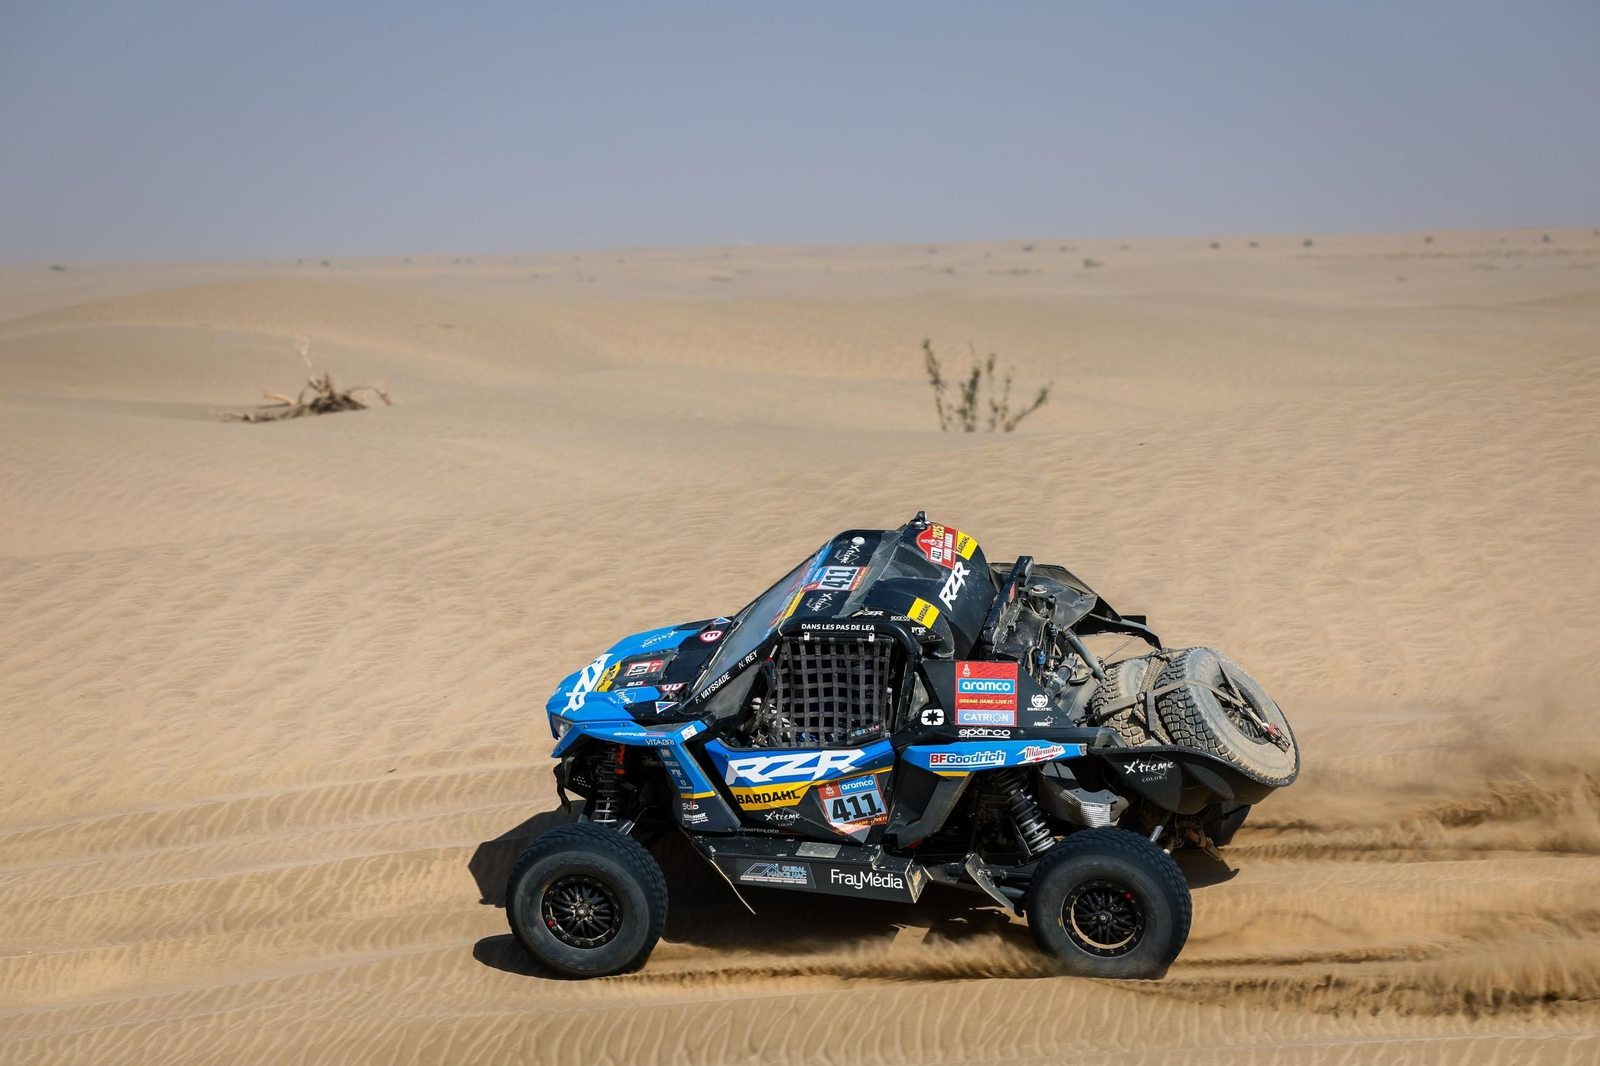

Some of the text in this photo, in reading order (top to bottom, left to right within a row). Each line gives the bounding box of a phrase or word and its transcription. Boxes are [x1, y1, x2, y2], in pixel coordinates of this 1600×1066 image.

[956, 536, 970, 554] BARDAHL
[821, 568, 858, 589] 411
[938, 561, 971, 611] RZR
[916, 604, 931, 622] BARDAHL
[745, 650, 758, 662] REY
[701, 671, 731, 699] VAYSSADE
[962, 681, 1011, 691] aramco
[963, 712, 1009, 723] CATRION
[958, 728, 1011, 738] sparco
[930, 751, 1005, 764] BFGoodrich
[1025, 746, 1063, 759] Milwaukee
[724, 749, 866, 786] RZR
[1123, 758, 1175, 775] X'treme
[841, 779, 874, 790] aramco
[1141, 775, 1163, 783] COLOR
[736, 789, 801, 805] BARDAHL
[832, 793, 882, 821] 411
[830, 868, 904, 890] FrayMédia
